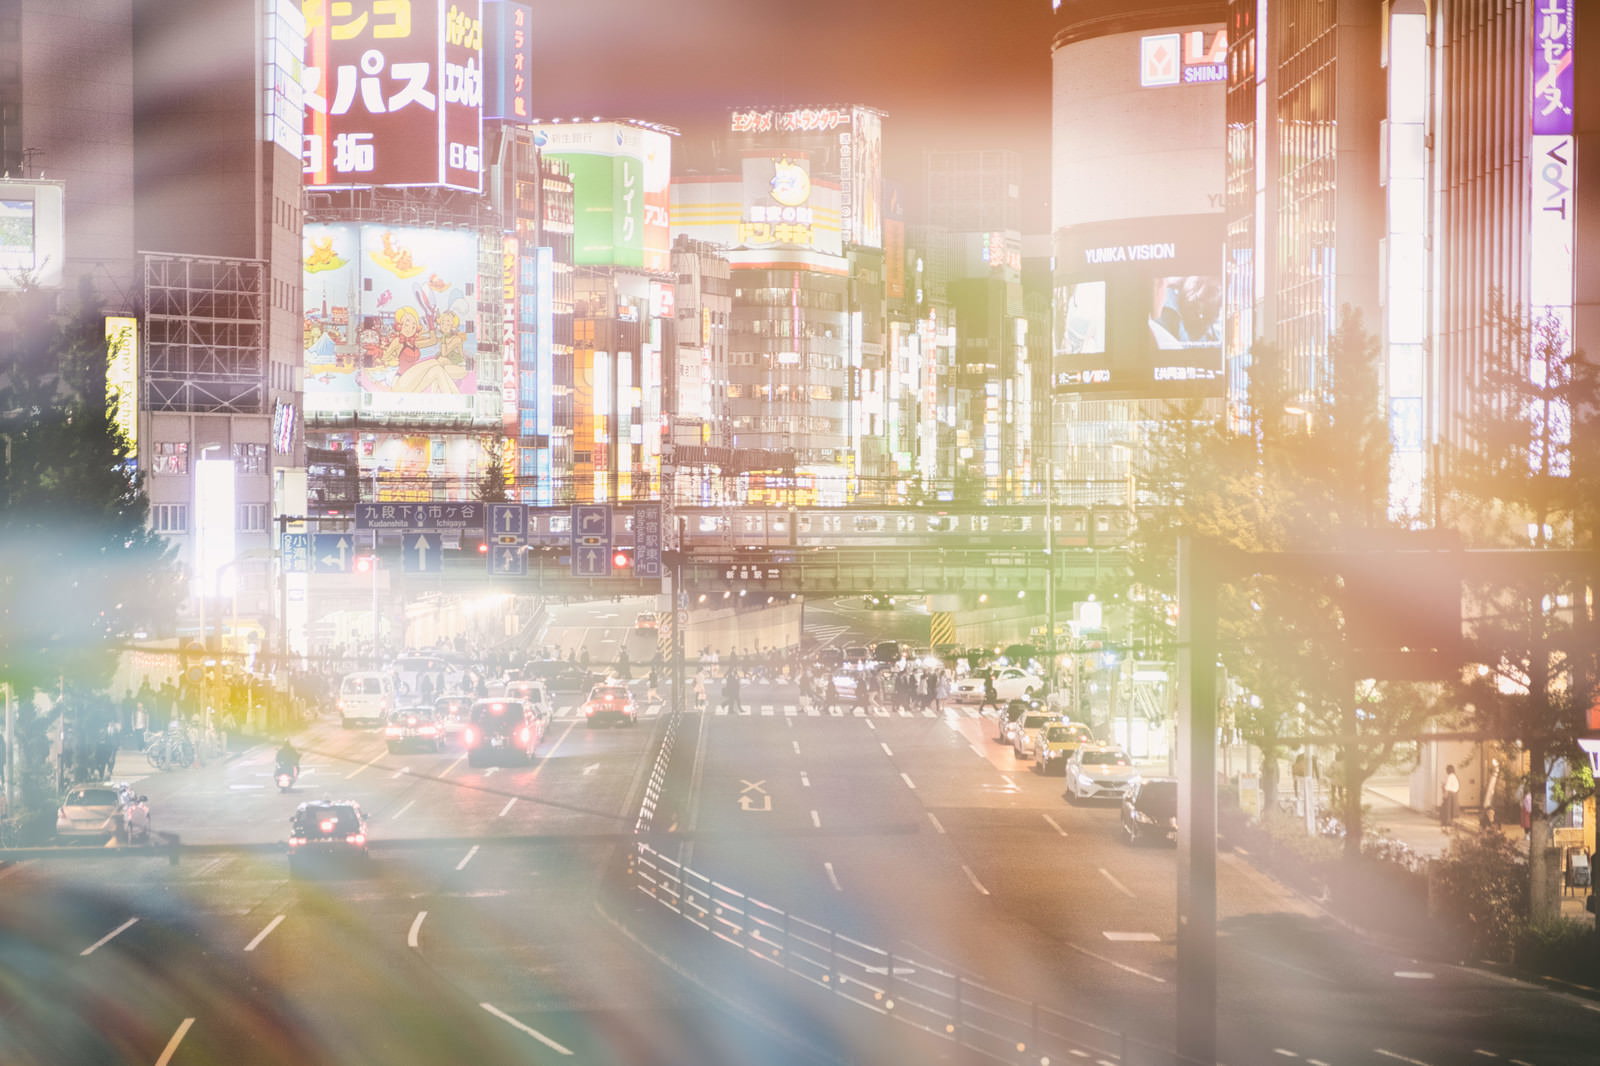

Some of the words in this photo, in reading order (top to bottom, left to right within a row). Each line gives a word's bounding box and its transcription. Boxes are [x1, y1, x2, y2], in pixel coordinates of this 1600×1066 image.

[623, 161, 635, 241] レイク
[1085, 247, 1126, 263] YUNIKA
[1127, 243, 1176, 260] VISION
[364, 505, 412, 519] 九段下
[368, 519, 409, 528] Kudanshita
[436, 519, 467, 528] Ichigaya
